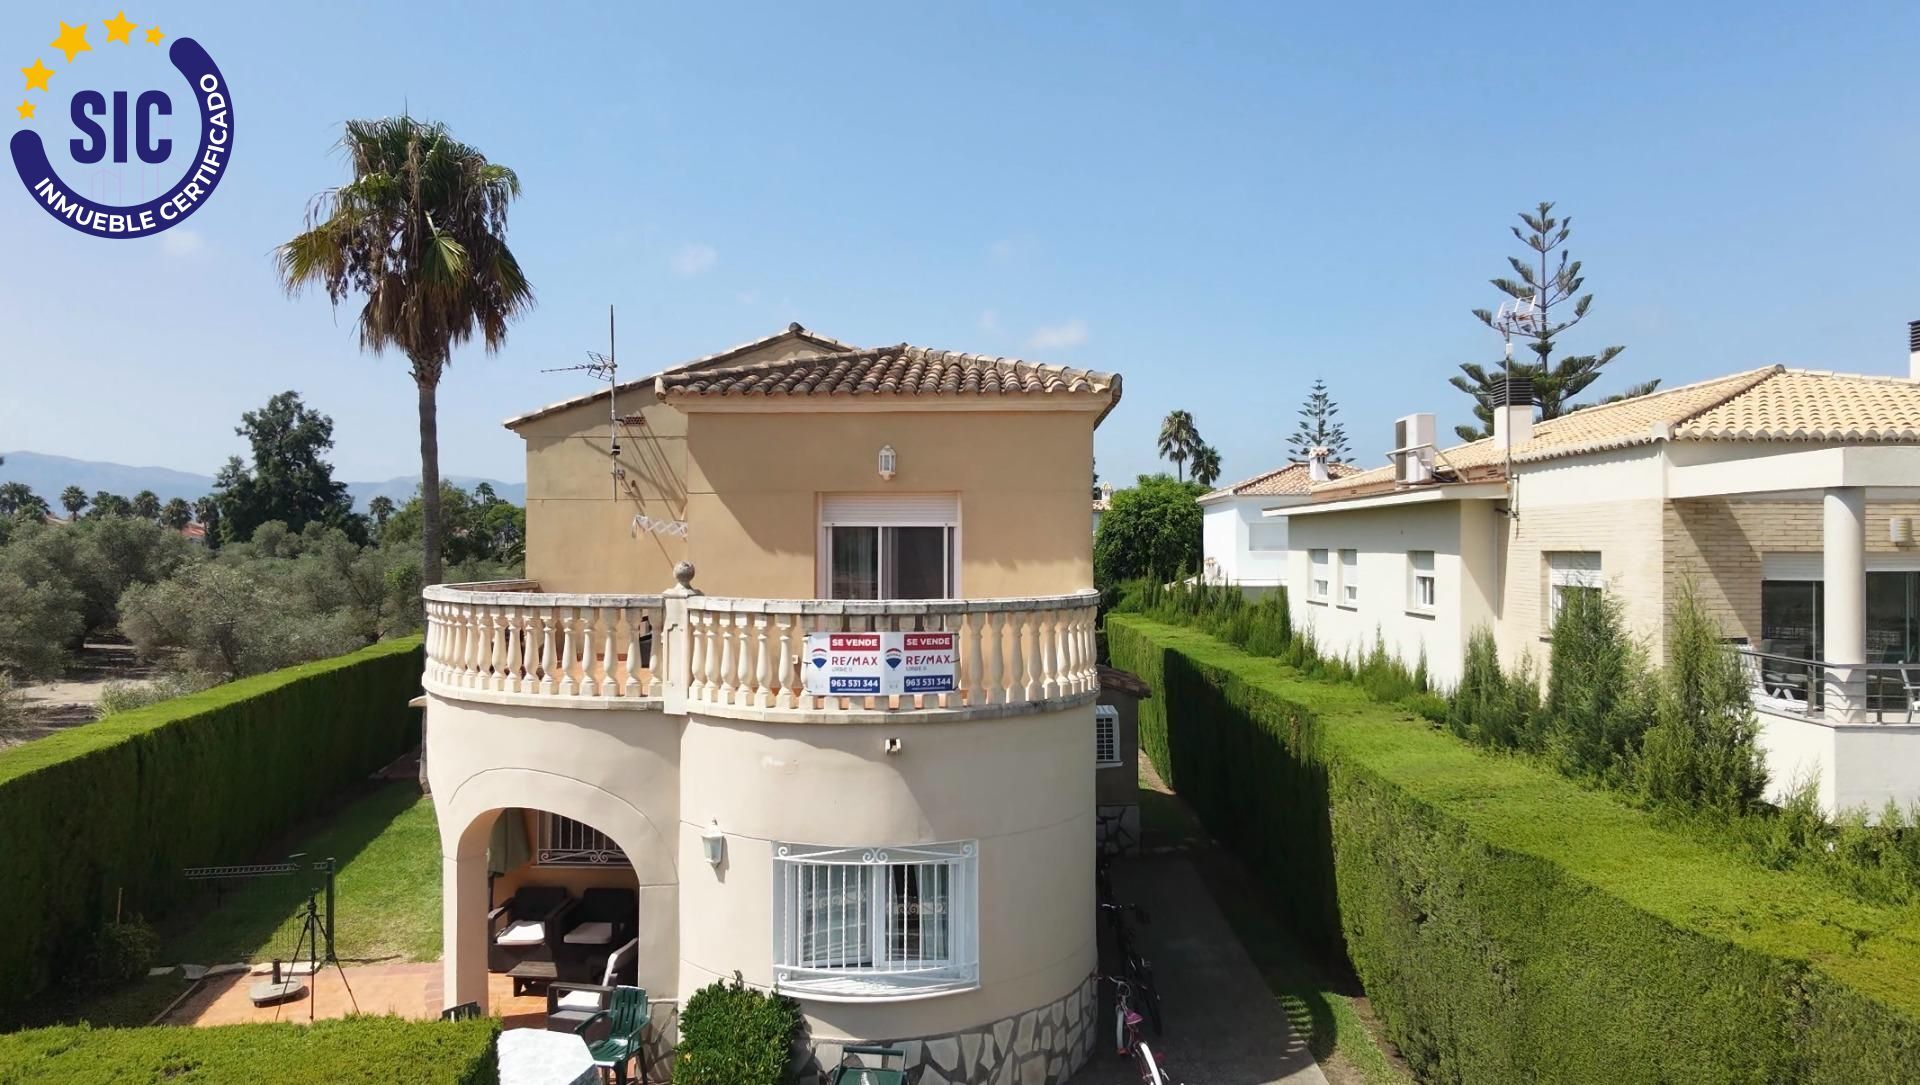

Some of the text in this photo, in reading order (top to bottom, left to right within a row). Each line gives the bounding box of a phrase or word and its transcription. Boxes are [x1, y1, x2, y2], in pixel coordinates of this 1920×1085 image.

[832, 638, 878, 646] SE VENDE
[906, 637, 950, 646] SE VENDE
[832, 656, 878, 666] RE/MAX
[906, 655, 951, 665] RE/MAX
[831, 679, 878, 687] 963 531 344
[905, 679, 920, 687] 963
[922, 678, 935, 686] 531
